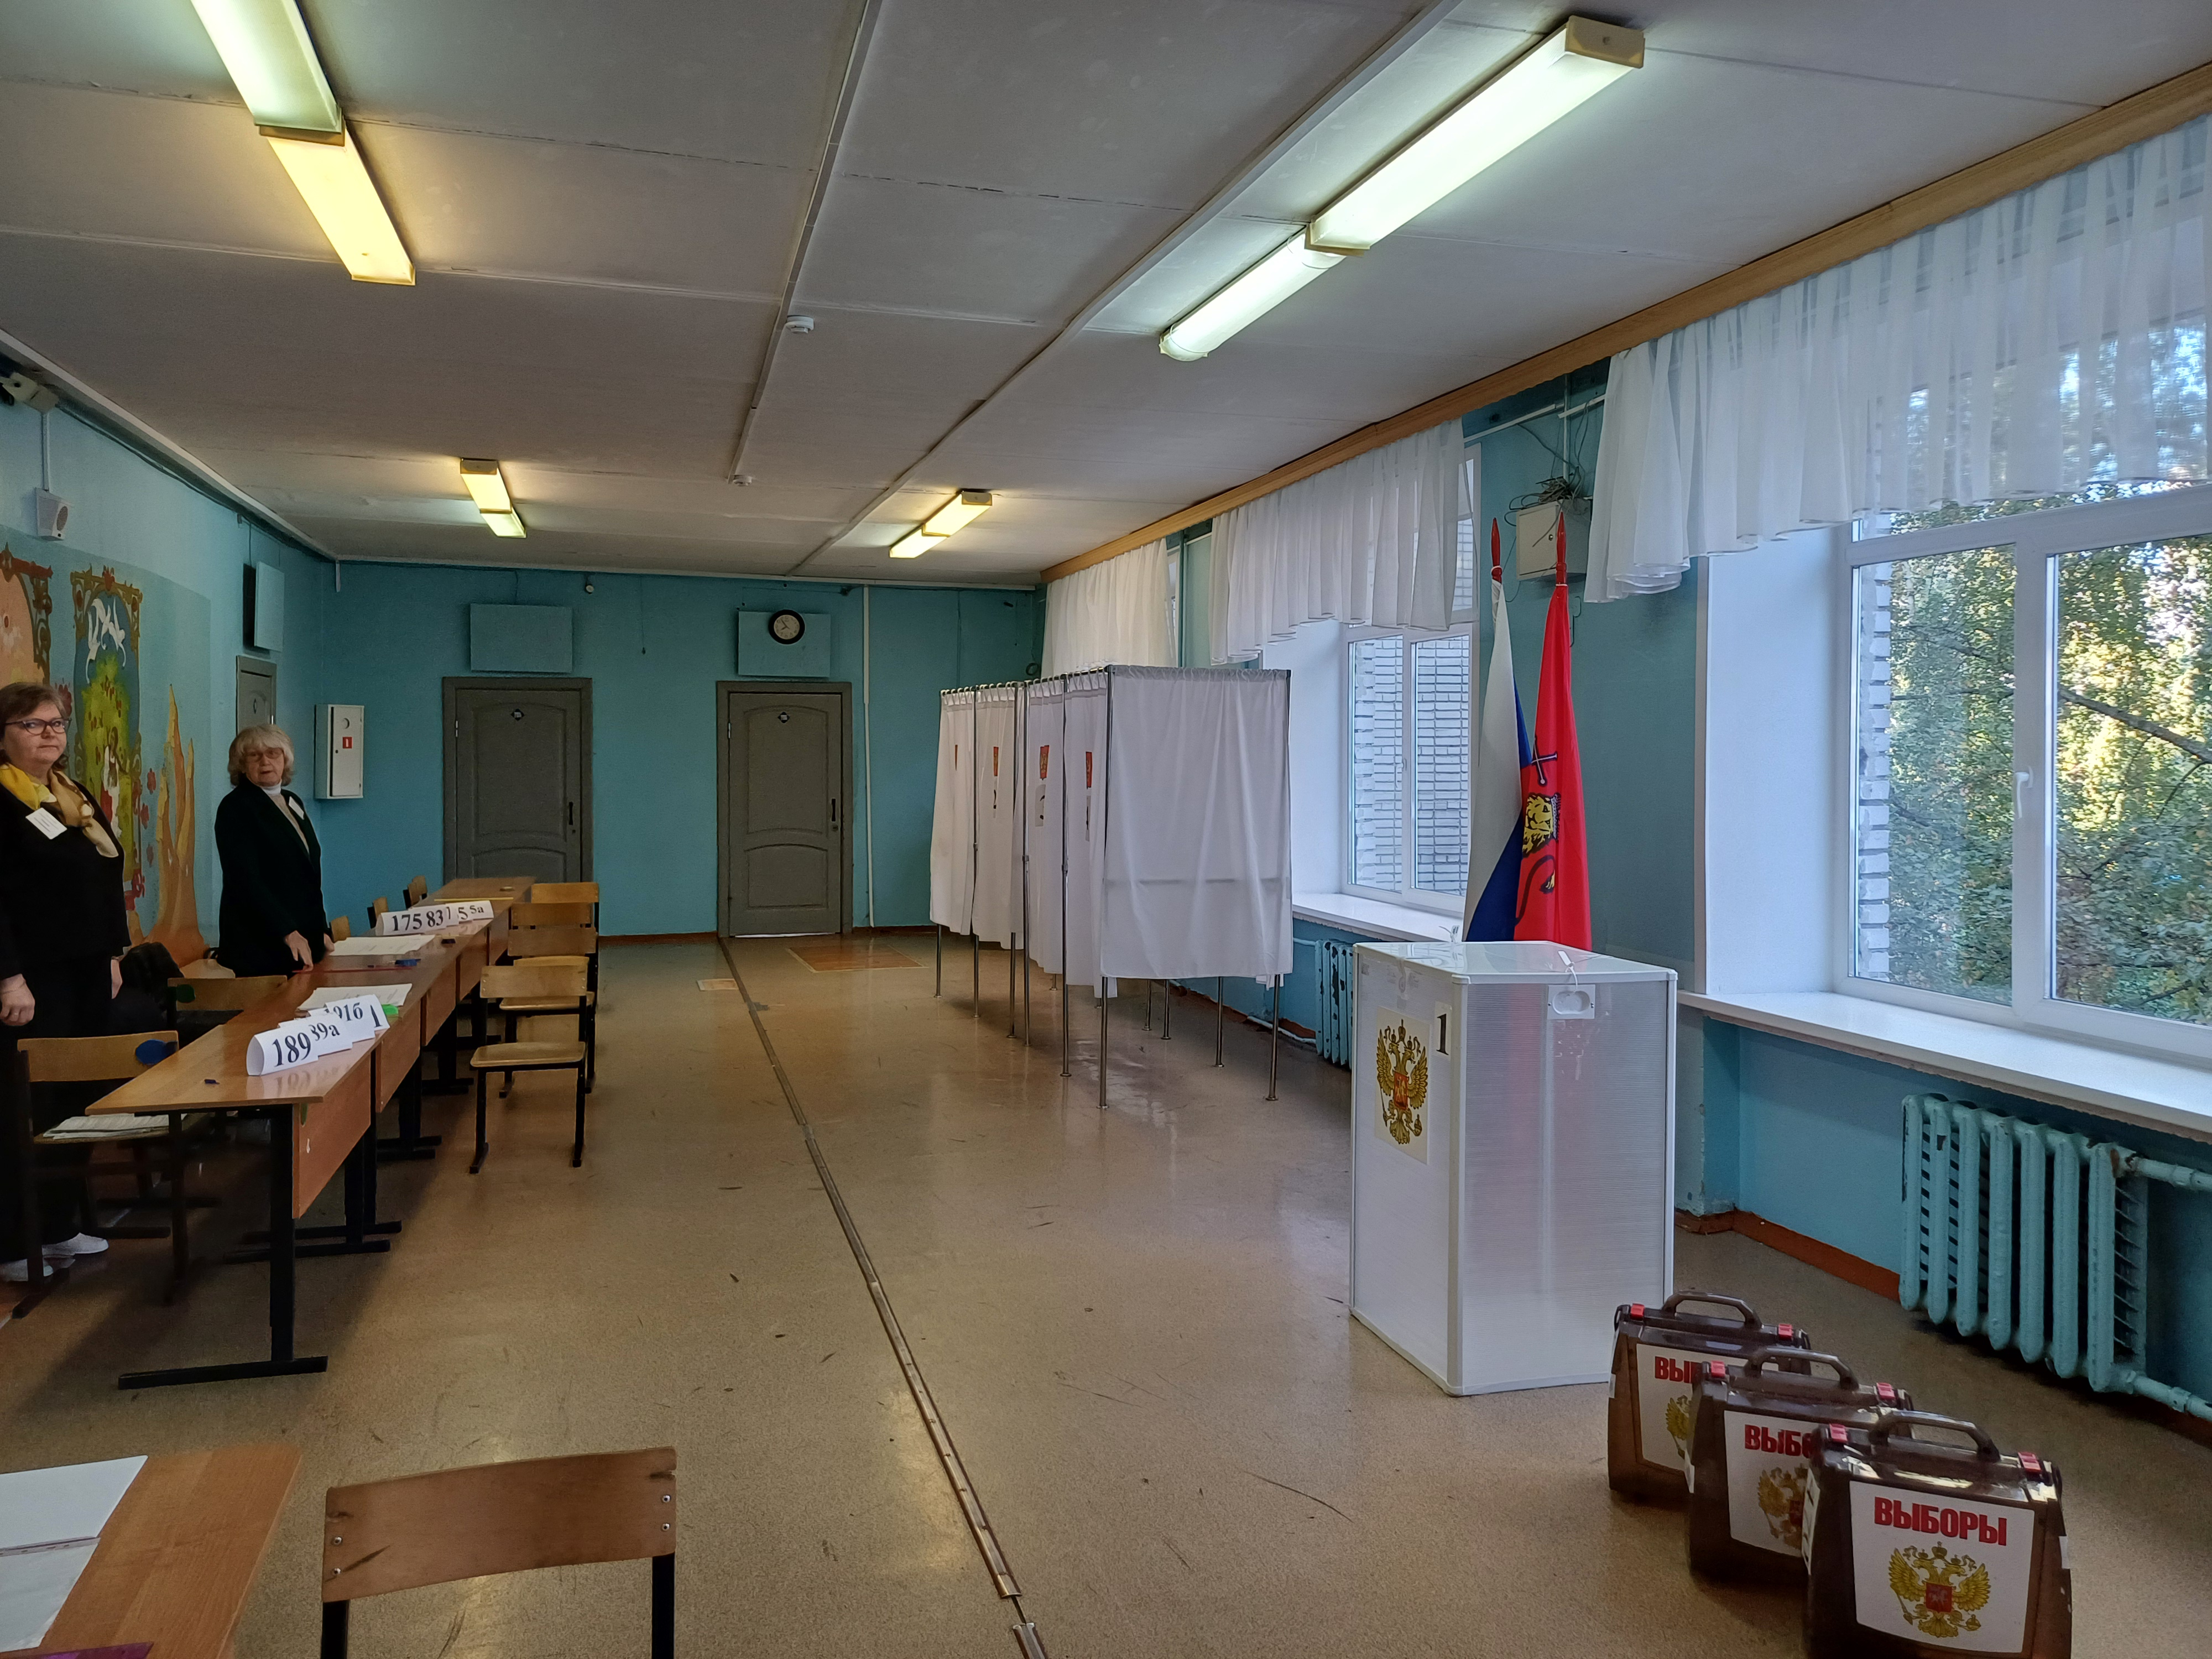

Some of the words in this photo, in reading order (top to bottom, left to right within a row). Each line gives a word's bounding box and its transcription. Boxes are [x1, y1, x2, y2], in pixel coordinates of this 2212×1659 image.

[391, 913, 422, 931] 175
[272, 1032, 311, 1067] 189
[1436, 1013, 1449, 1055] 1
[1874, 1496, 2007, 1546] ВЫБОРЫ
